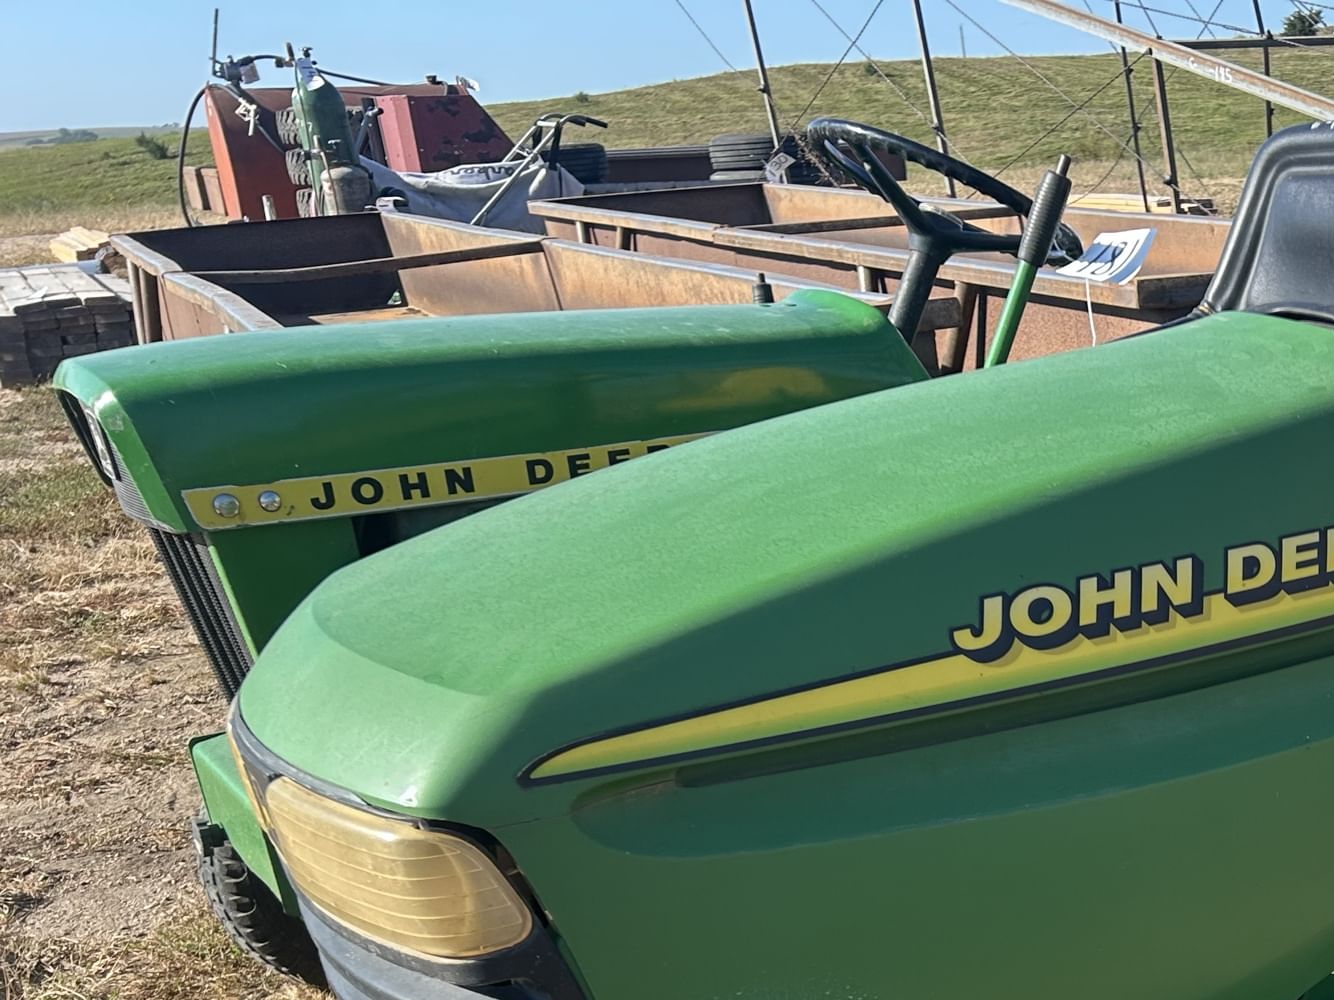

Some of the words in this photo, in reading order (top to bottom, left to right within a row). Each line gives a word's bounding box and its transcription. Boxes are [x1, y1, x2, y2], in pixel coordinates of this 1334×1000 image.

[309, 466, 475, 511] JOHN
[526, 444, 674, 486] DEE
[952, 556, 1203, 662] JOHN
